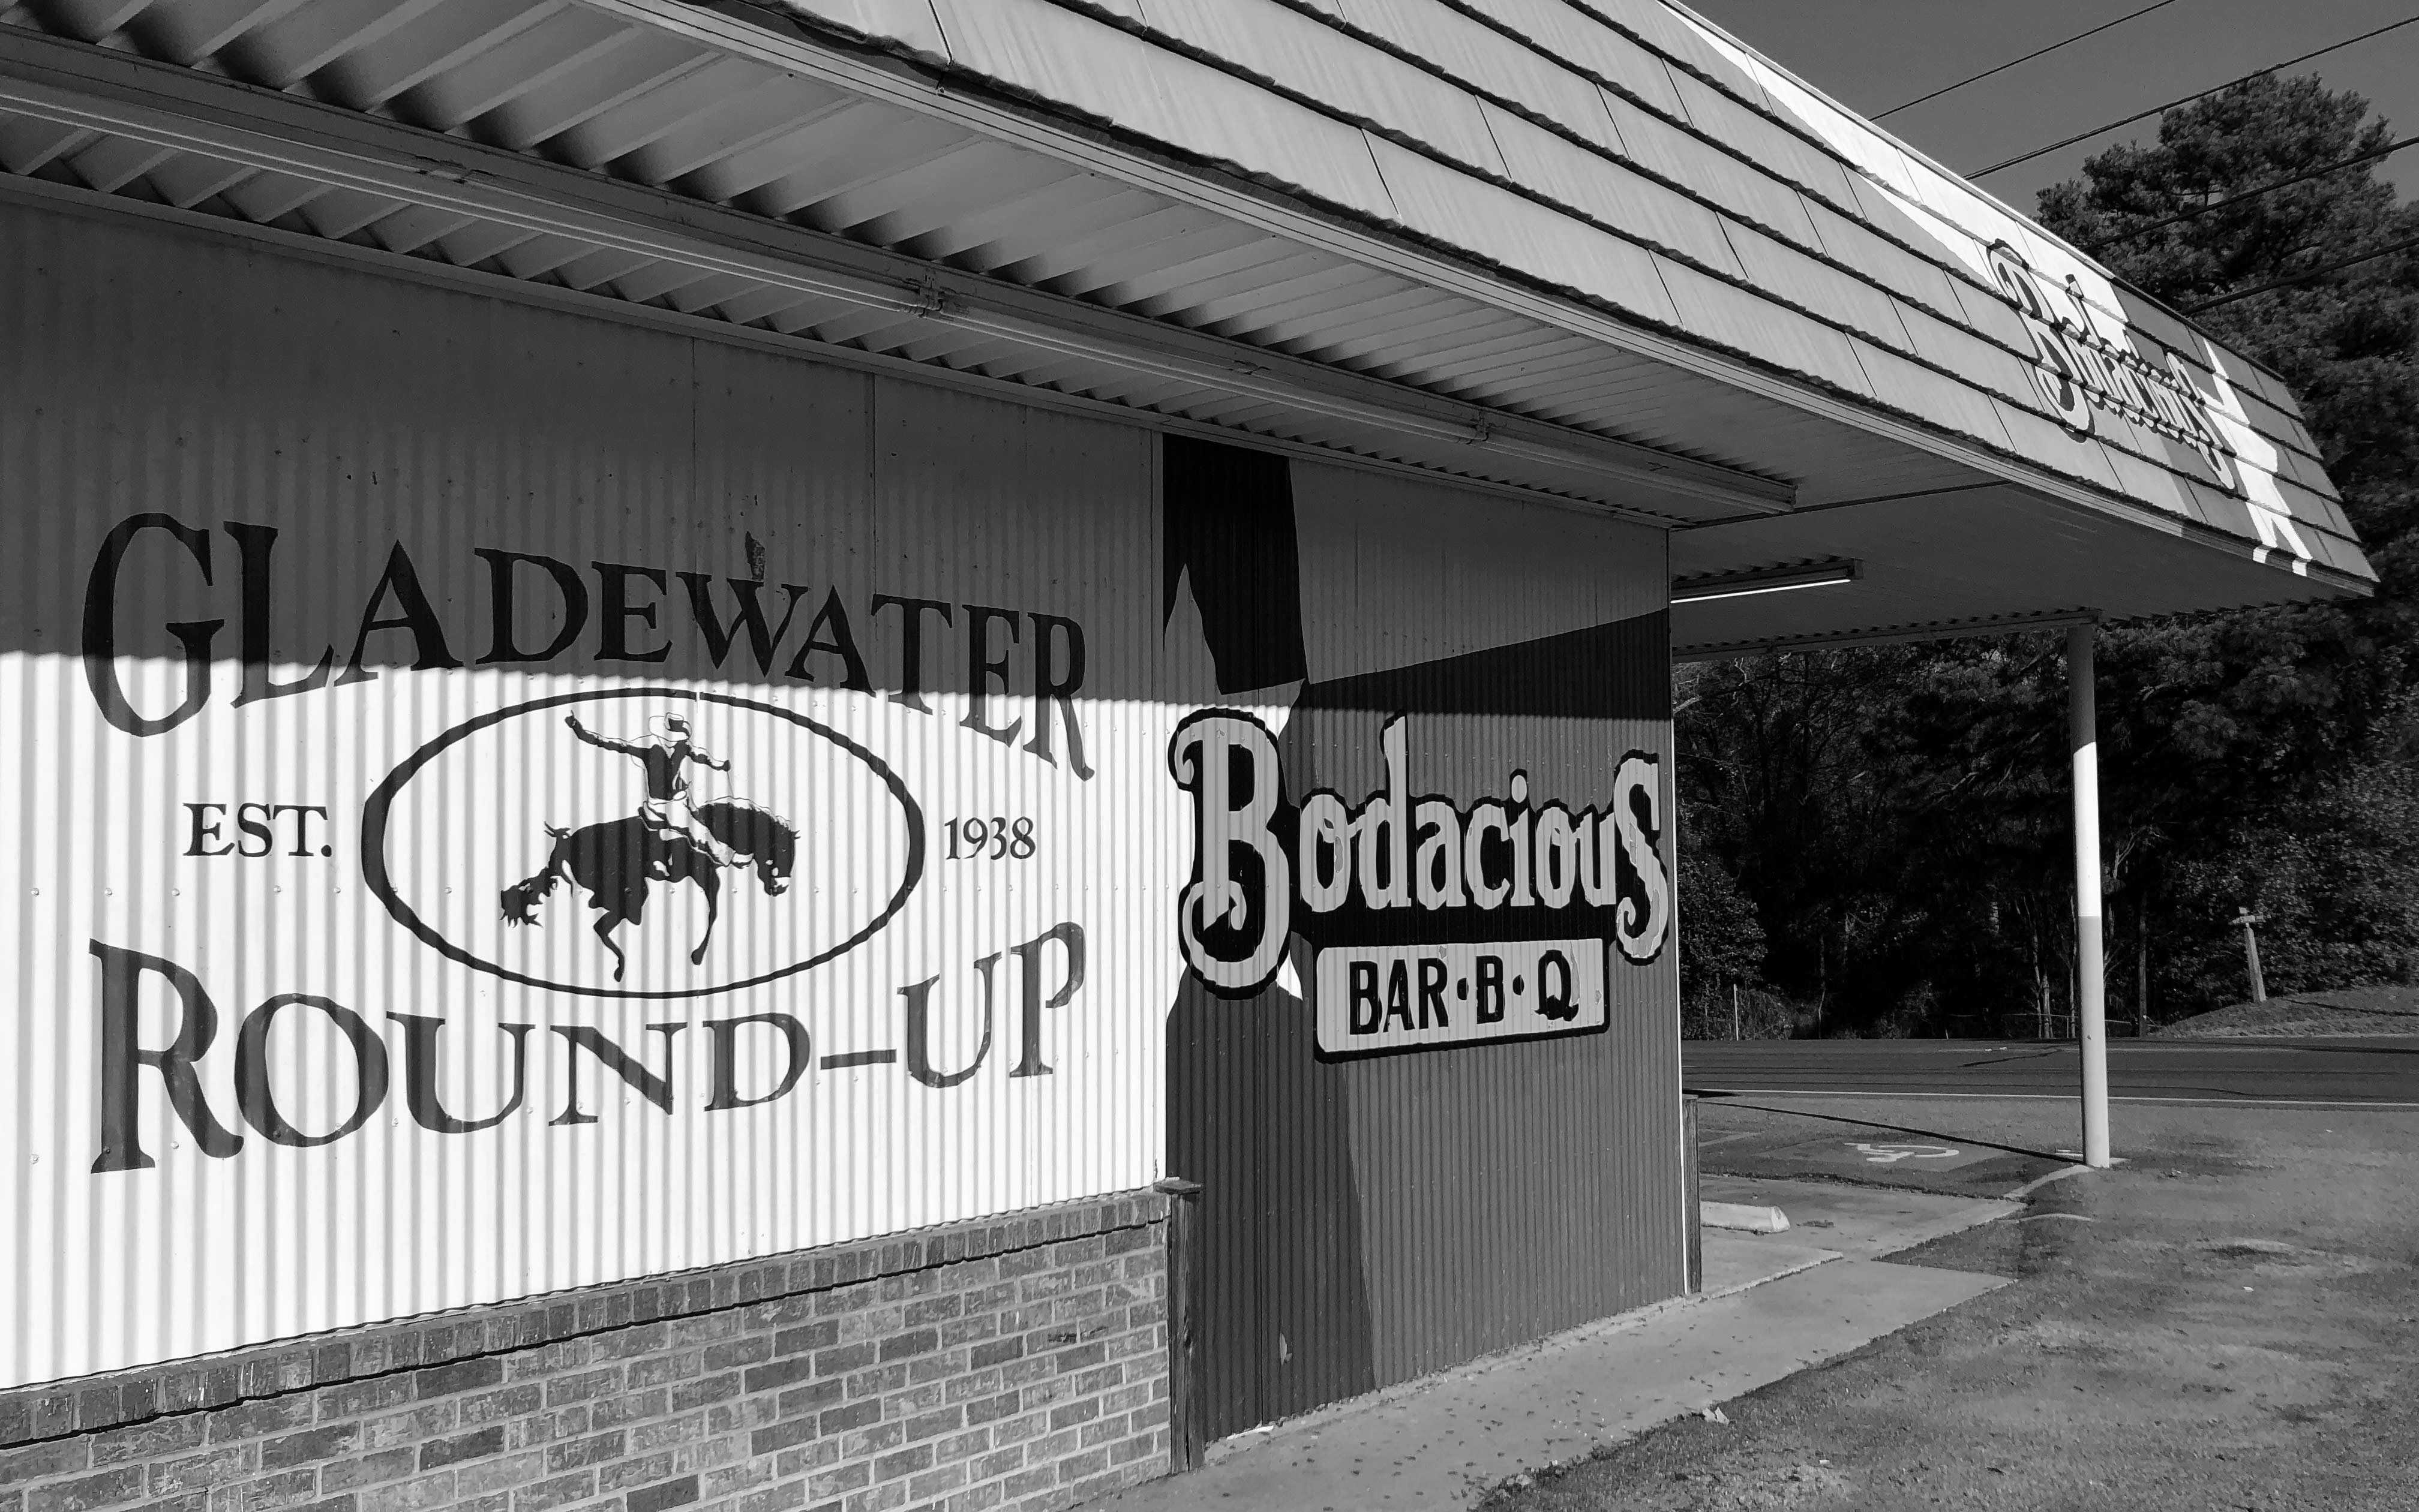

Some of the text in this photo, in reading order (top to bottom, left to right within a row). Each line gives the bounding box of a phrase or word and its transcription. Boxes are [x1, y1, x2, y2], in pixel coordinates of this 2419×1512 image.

[82, 512, 1095, 781] GLADEWATER
[183, 802, 1036, 861] EST. 1938
[89, 921, 1086, 1174] ROUND-UP
